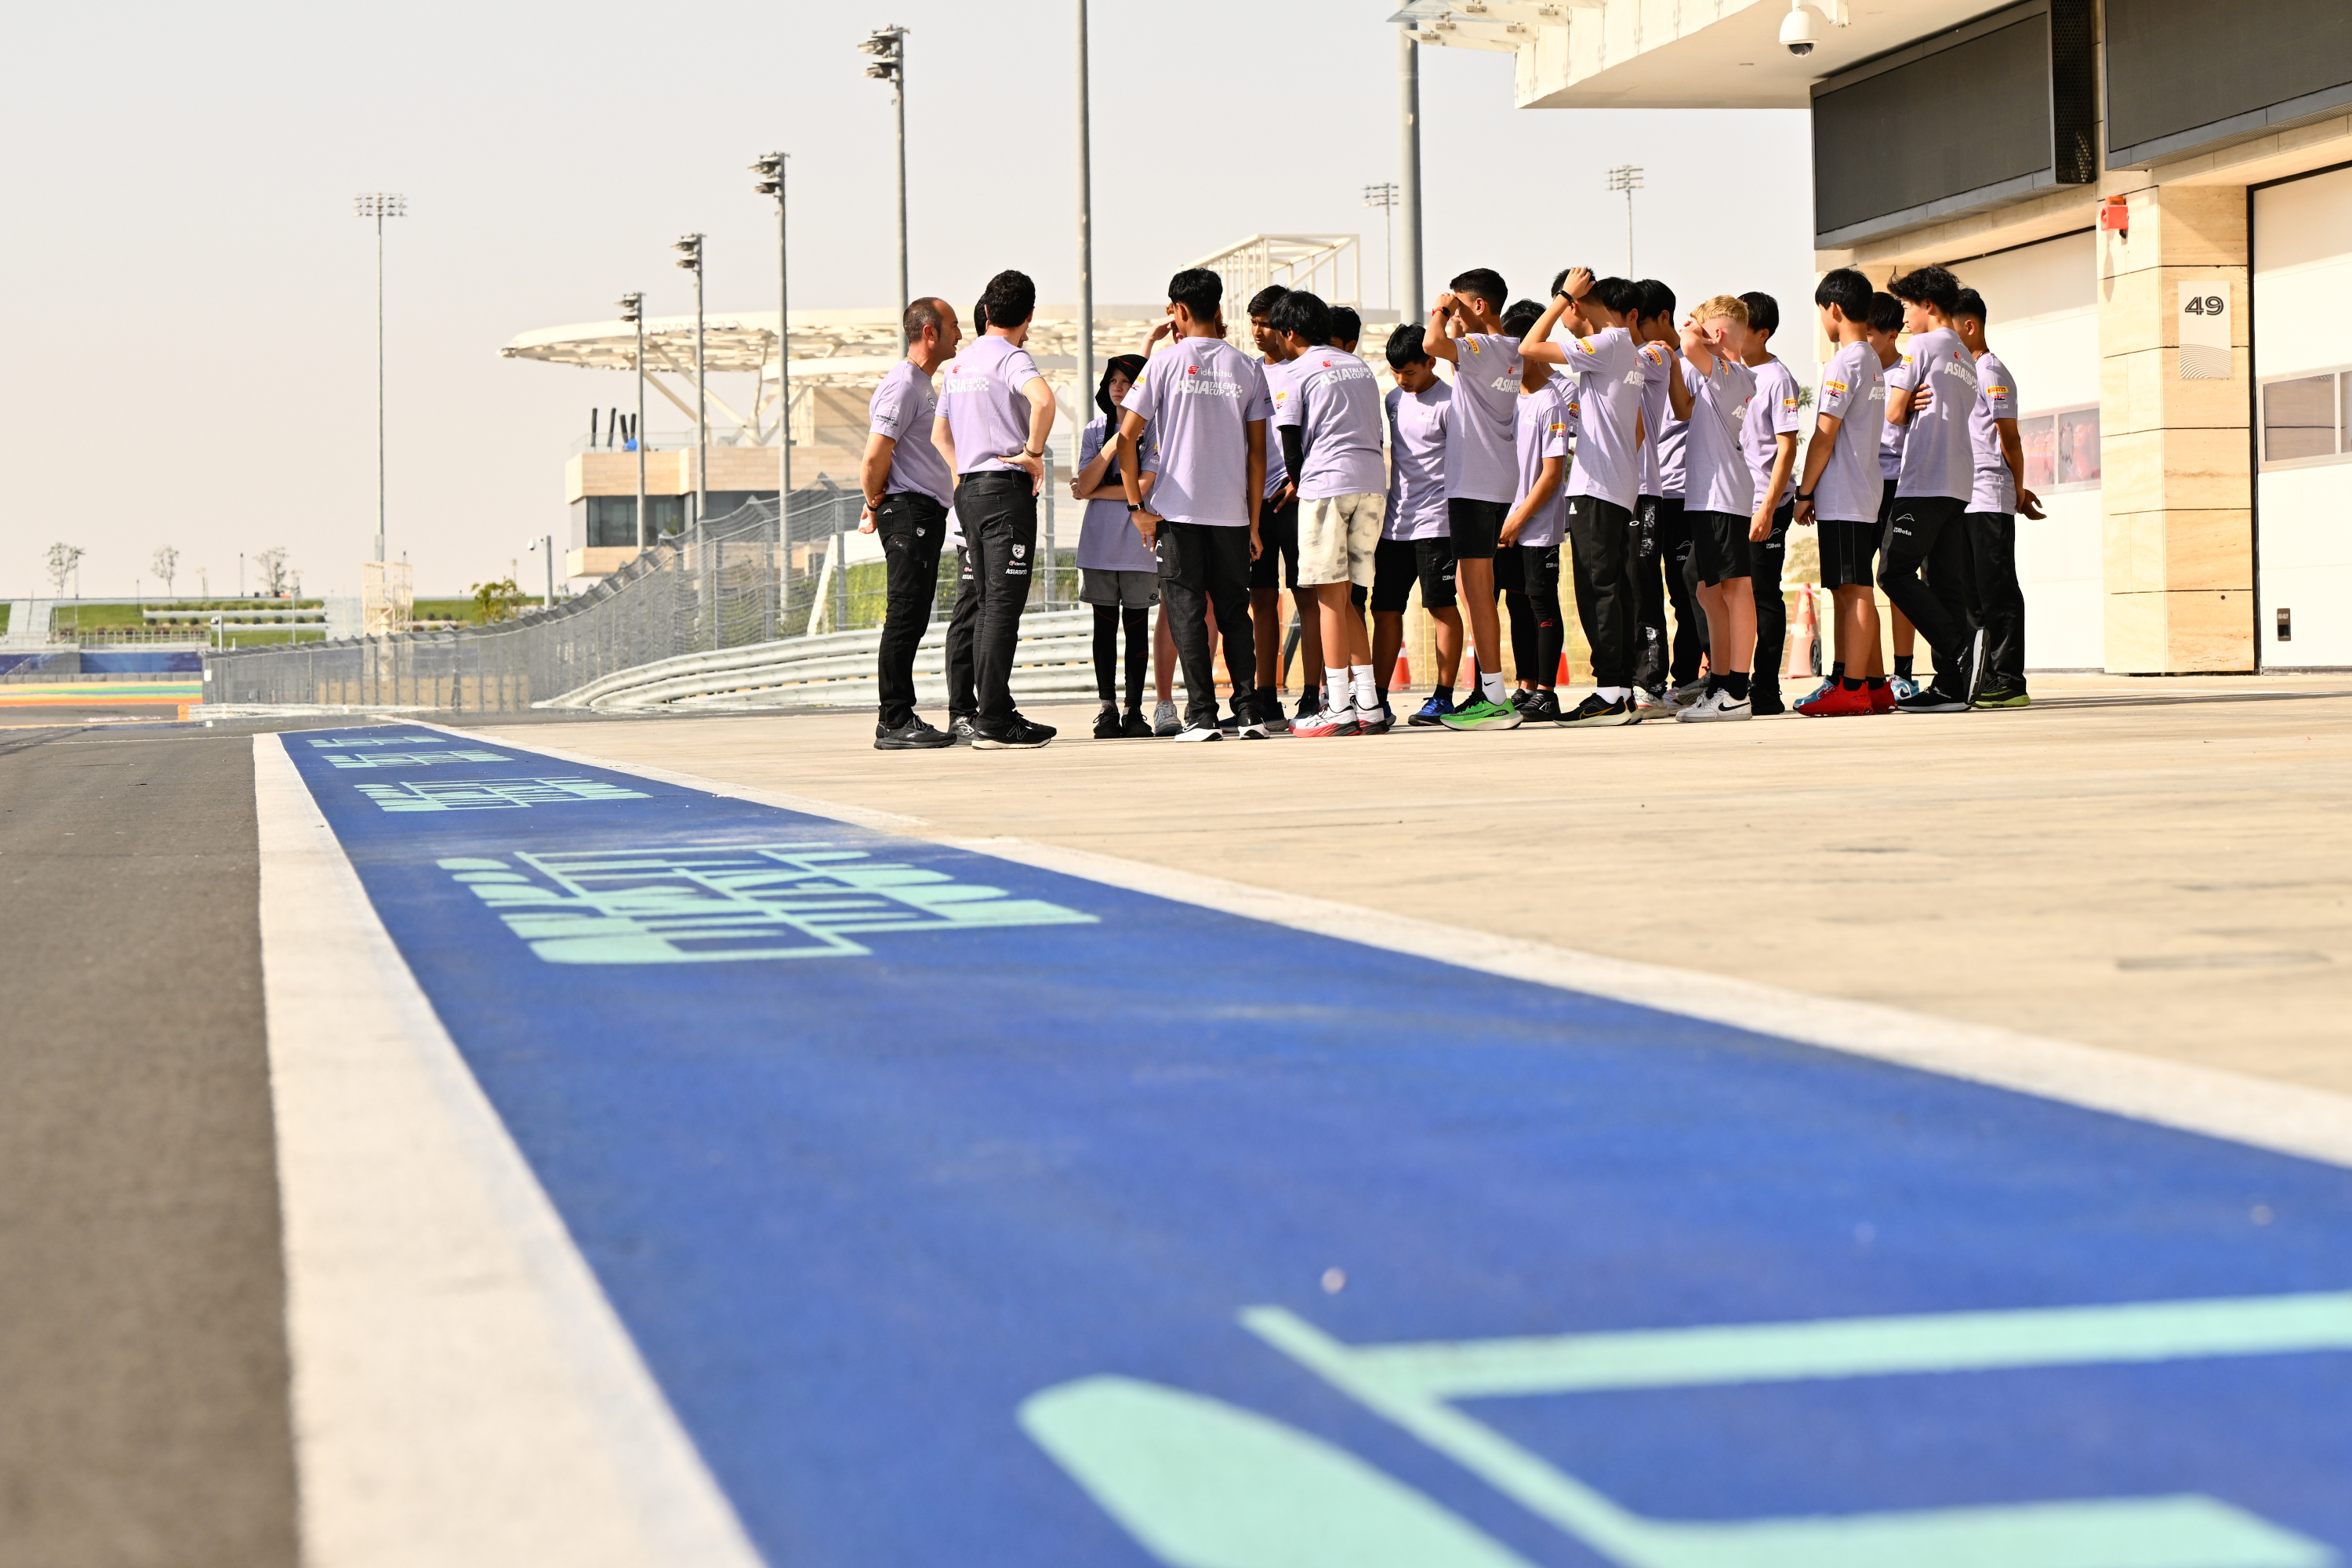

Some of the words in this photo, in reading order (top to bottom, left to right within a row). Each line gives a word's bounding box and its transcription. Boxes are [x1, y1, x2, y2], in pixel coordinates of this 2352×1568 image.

[2184, 296, 2224, 315] 49
[1200, 366, 1232, 378] idemitsu
[1319, 368, 1352, 390] ASIA
[1944, 361, 1965, 381] ASIA
[1175, 379, 1210, 395] ASIA
[1209, 381, 1238, 390] TALENT
[1490, 376, 1514, 393] ASIA
[1826, 381, 1845, 390] PIRELLI
[1897, 528, 1911, 536] Beta
